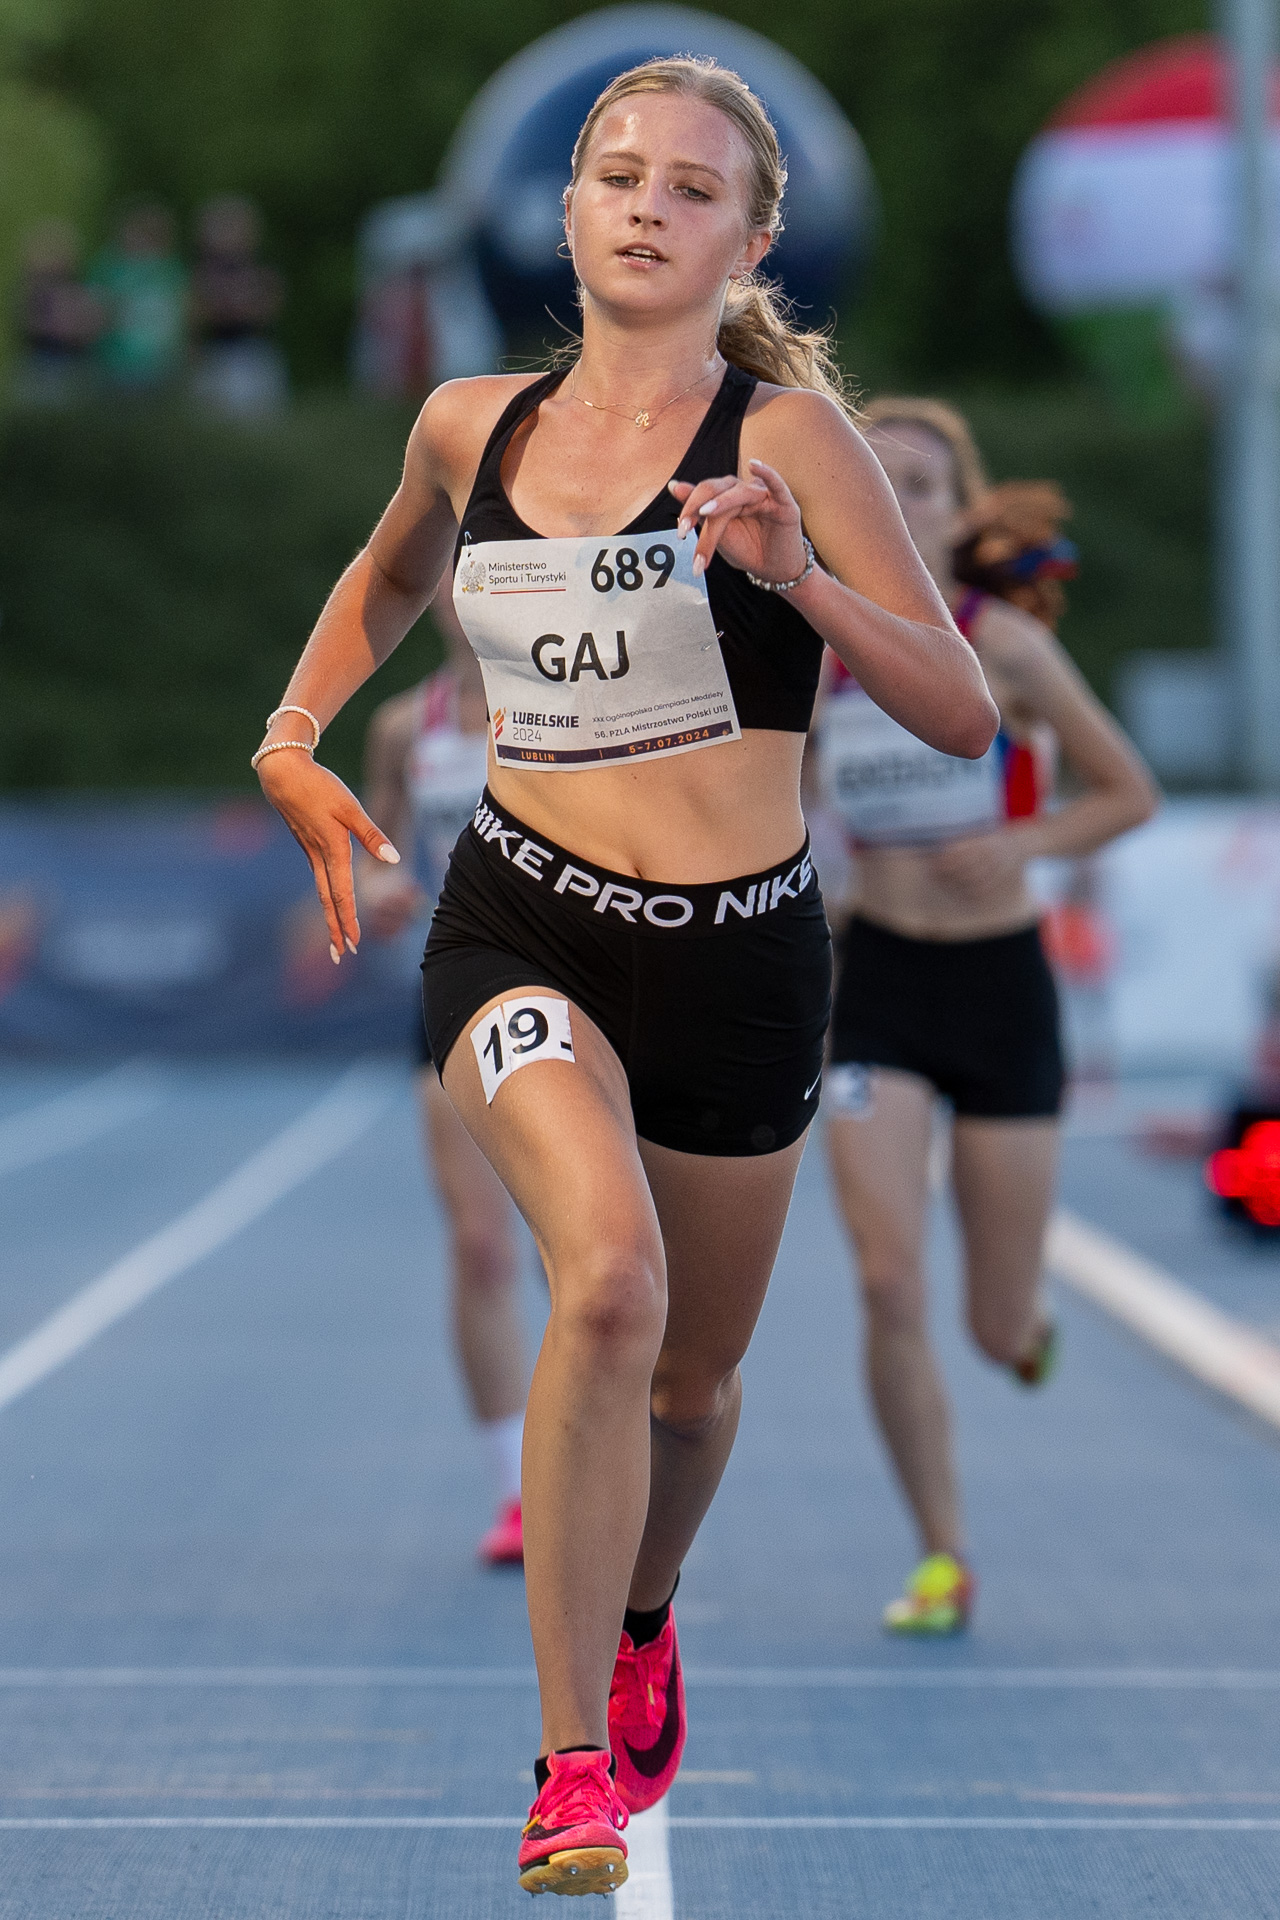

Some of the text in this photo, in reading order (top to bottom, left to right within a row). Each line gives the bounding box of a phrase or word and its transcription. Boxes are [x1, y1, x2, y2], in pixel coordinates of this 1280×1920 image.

[488, 562, 547, 571] Ministerstwo
[591, 544, 675, 593] 689
[489, 574, 518, 585] Sportu
[526, 571, 566, 583] Turystyki
[531, 630, 630, 682] GAJ
[653, 697, 690, 712] Olimpiada
[512, 711, 579, 728] LUBELSKIE
[594, 704, 729, 739] 56. PZLA Mistrzostwa Polski U18
[513, 727, 542, 742] 2024
[628, 729, 710, 754] 5-7.07.2024
[521, 751, 555, 762] LUBLIN
[553, 863, 694, 928] PRO
[713, 848, 812, 924] NIKE
